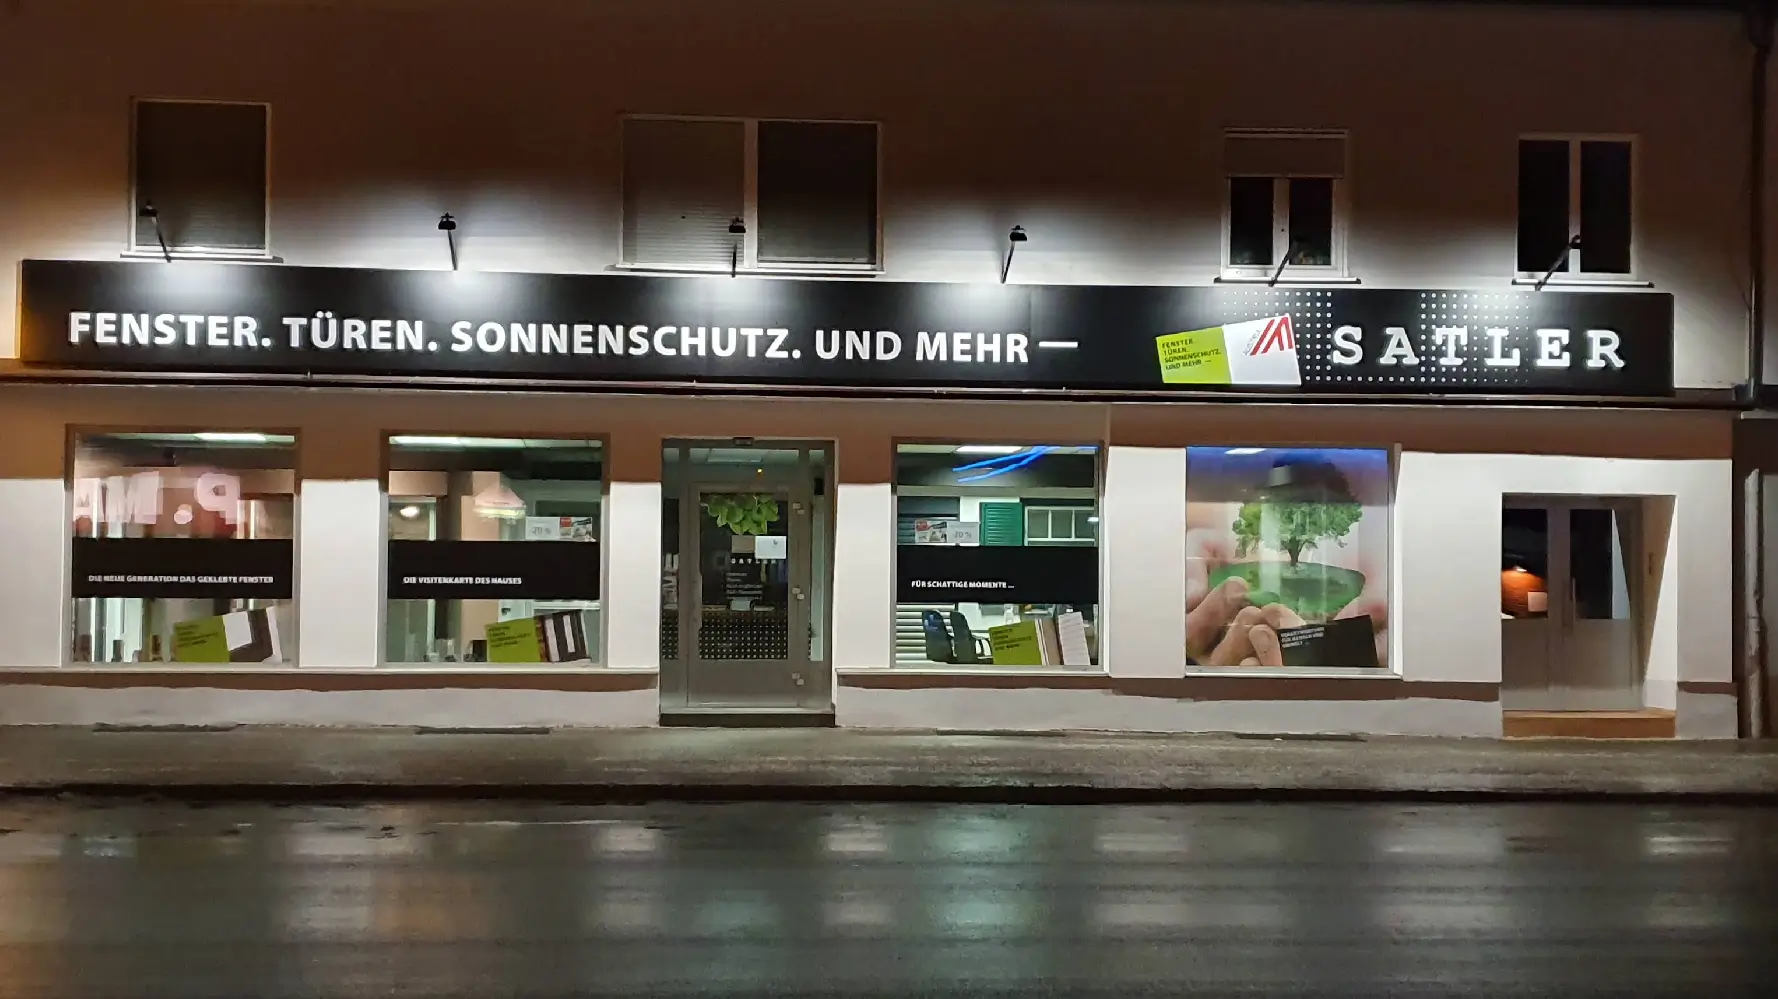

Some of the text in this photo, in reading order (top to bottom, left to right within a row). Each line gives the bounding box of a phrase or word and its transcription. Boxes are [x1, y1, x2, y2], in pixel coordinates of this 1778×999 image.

[68, 310, 272, 347] FENSTER.
[282, 310, 438, 351] TÜREN.
[450, 320, 802, 359] SONNENSCHUTZ.
[815, 329, 901, 361] UND
[915, 331, 1029, 363] MEHR
[1331, 325, 1627, 368] SATLER
[126, 575, 179, 583] GENERATION
[238, 576, 274, 584] FENSTER
[402, 576, 417, 584] DIE
[418, 576, 474, 584] VISITENKARTE
[911, 579, 926, 588] FÜR
[926, 580, 968, 588] SCHATTIGE
[969, 581, 1007, 589] MOMENTE
